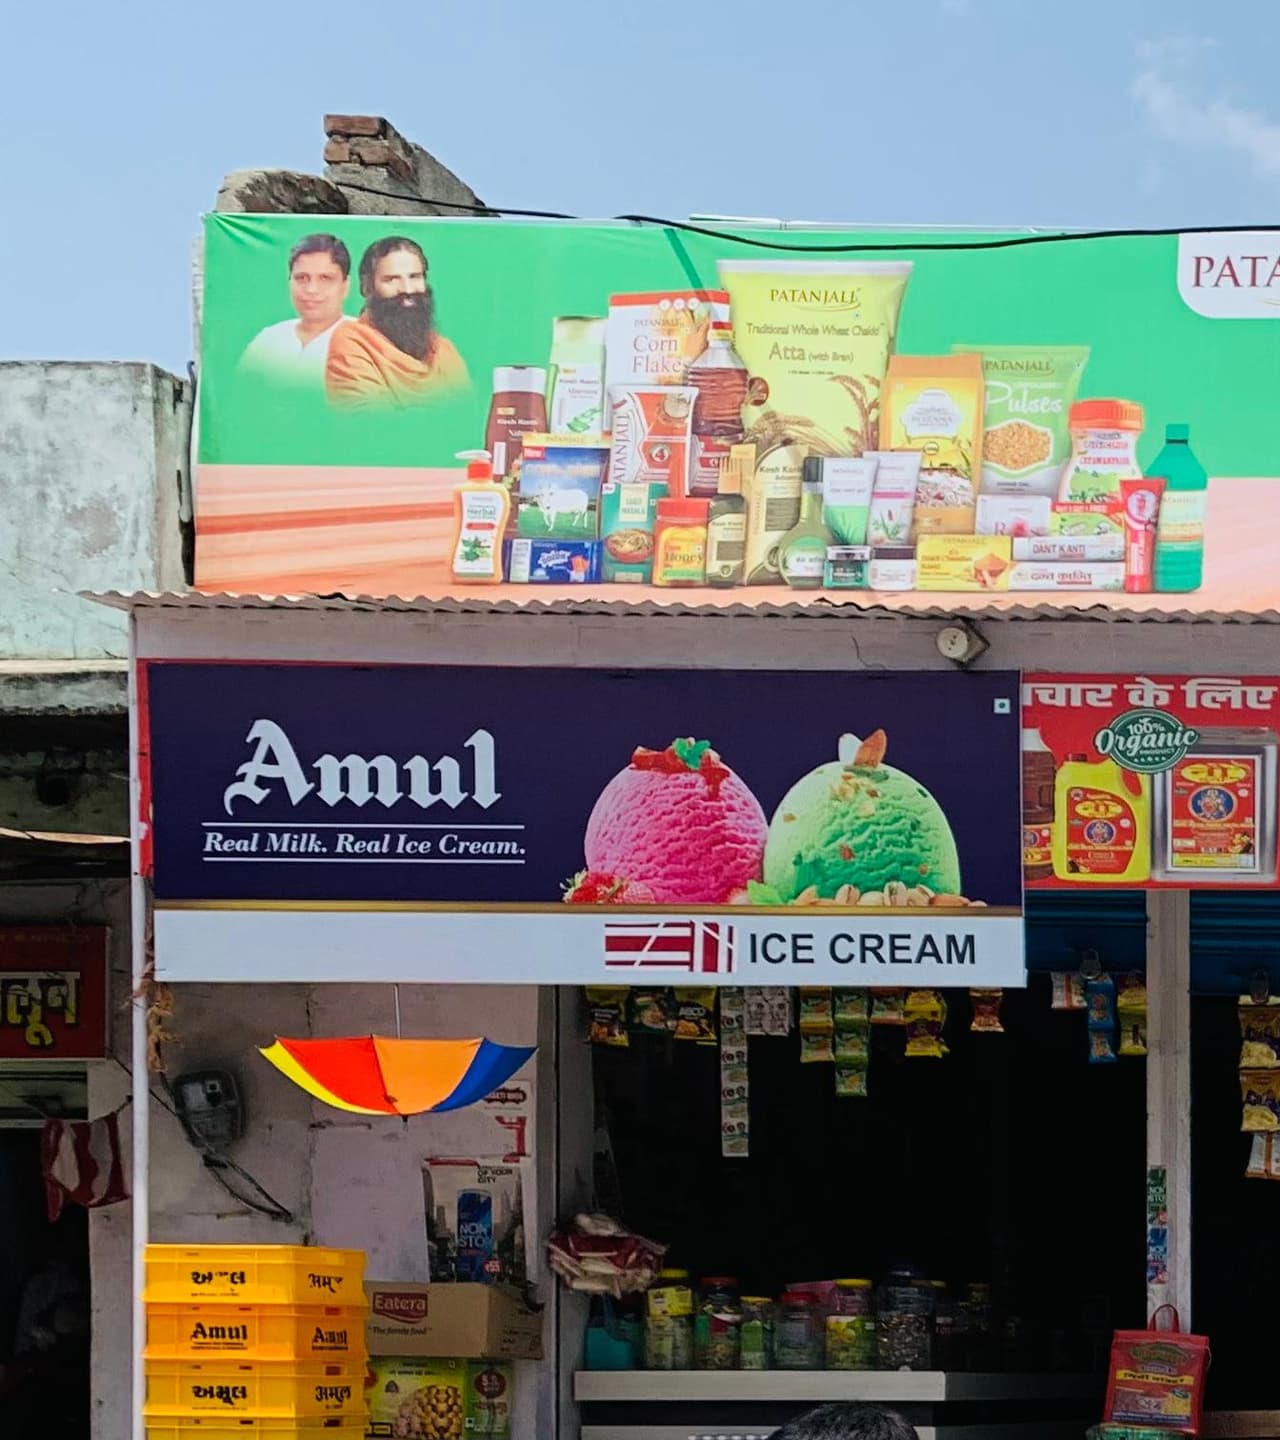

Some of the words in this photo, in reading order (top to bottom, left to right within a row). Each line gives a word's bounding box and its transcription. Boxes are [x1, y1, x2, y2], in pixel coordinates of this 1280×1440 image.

[770, 289, 859, 304] PATANJALI
[747, 323, 789, 335] Traditional
[791, 323, 819, 336] Whole
[633, 335, 678, 352] Corn
[769, 342, 805, 360] Atta
[984, 380, 1063, 413] Pulses
[1124, 676, 1175, 708] के
[1181, 677, 1279, 710] लिए
[1095, 727, 1198, 757] Organic
[223, 717, 502, 818] Amul
[203, 832, 259, 855] Real
[265, 832, 325, 855] Milk.
[335, 832, 390, 855] Real
[395, 833, 433, 855] Ice
[438, 833, 526, 856] Cream.
[748, 932, 815, 966] ICE
[827, 931, 978, 967] CREAM
[190, 1321, 248, 1340] Amul
[312, 1326, 349, 1345] Amul
[191, 1385, 249, 1406] અમૂલ
